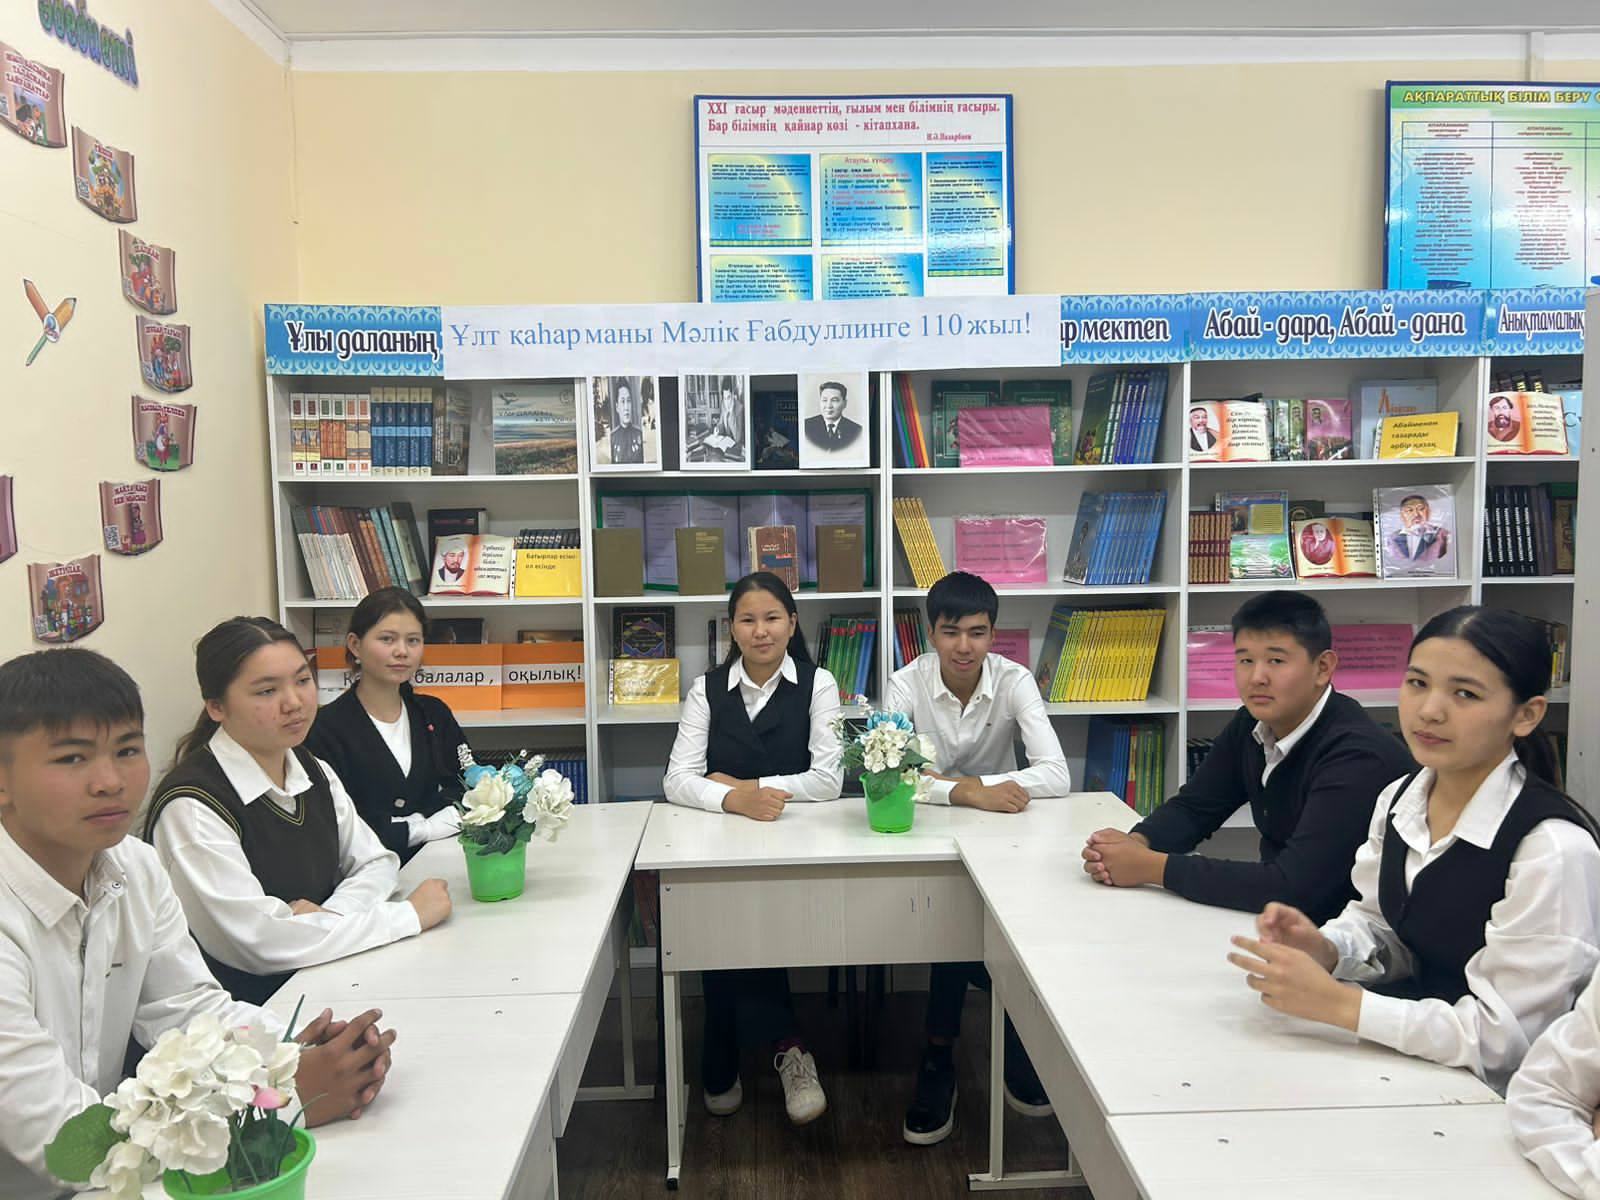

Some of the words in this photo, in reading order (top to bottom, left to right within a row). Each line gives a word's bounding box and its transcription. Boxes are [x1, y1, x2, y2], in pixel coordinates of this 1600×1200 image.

[1403, 90, 1503, 104] АҚПАРАТТЫҚ
[1508, 91, 1550, 103] БІЛІМ
[1555, 91, 1591, 103] БЕРУ
[708, 102, 727, 114] XXI
[735, 103, 766, 117] ғасыр
[846, 103, 881, 115] ғылым
[886, 103, 905, 113] мен
[909, 100, 954, 114] білімнің
[958, 102, 1000, 115] ғасыры.
[708, 119, 729, 134] Бар
[732, 119, 778, 133] білімнің
[784, 119, 823, 134] қайнар
[827, 118, 848, 131] көзі
[863, 118, 920, 131] кітапхана.
[449, 324, 500, 346] Ұлт
[662, 320, 739, 343] Мәлік
[746, 319, 910, 346] Ғабдуллинге
[920, 313, 962, 337] 110
[967, 312, 1031, 335] жыл!
[1083, 321, 1169, 341] мектеп
[1205, 307, 1260, 337] Абай
[1276, 316, 1334, 344] дара,
[1340, 305, 1395, 336] Абай
[1412, 314, 1465, 341] дана
[1500, 305, 1585, 338] Анықтамалық
[287, 322, 332, 351] Ұлы
[338, 331, 438, 361] даланың
[415, 669, 485, 686] балалар
[509, 665, 581, 684] оқылық!
